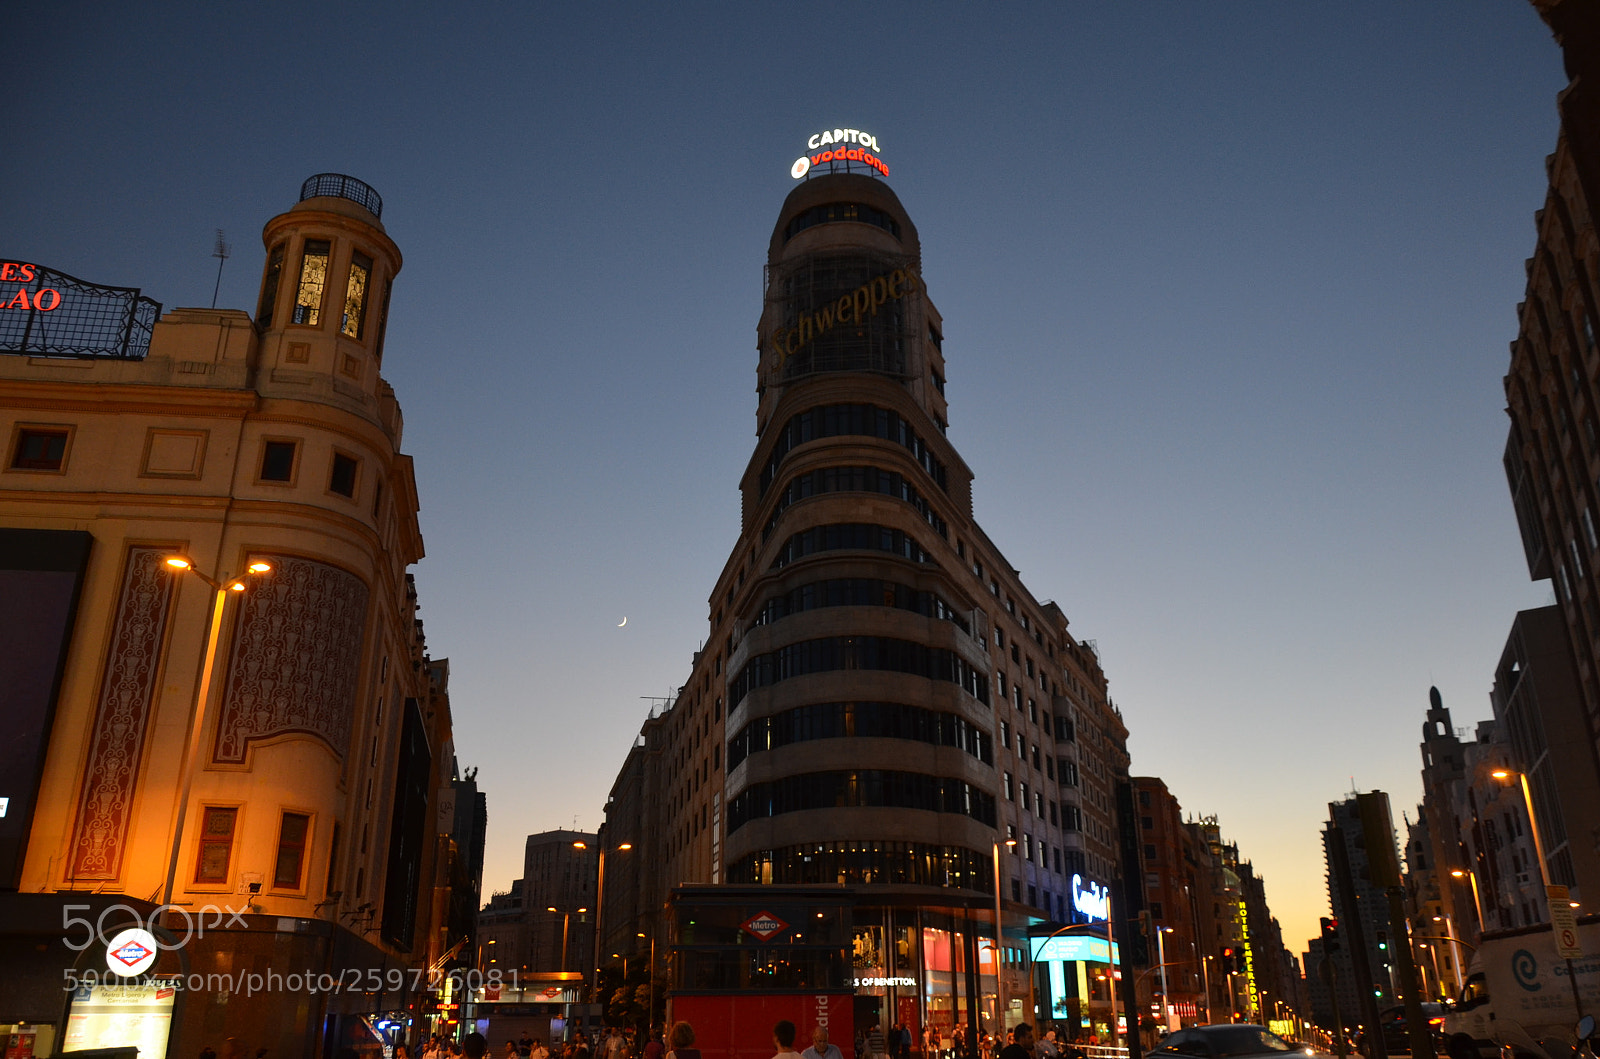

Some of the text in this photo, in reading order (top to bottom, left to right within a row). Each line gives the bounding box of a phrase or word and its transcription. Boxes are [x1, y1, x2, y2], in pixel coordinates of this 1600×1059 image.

[808, 128, 881, 153] CAPITOL
[811, 145, 890, 177] vodafone
[770, 262, 919, 375] Schweppes
[1072, 873, 1109, 923] Capitol
[752, 921, 776, 930] Metro
[119, 948, 143, 958] Metro
[1238, 901, 1259, 1011] HOTEL EMPERADOR
[861, 977, 874, 987] OF
[815, 994, 830, 1030] drid
